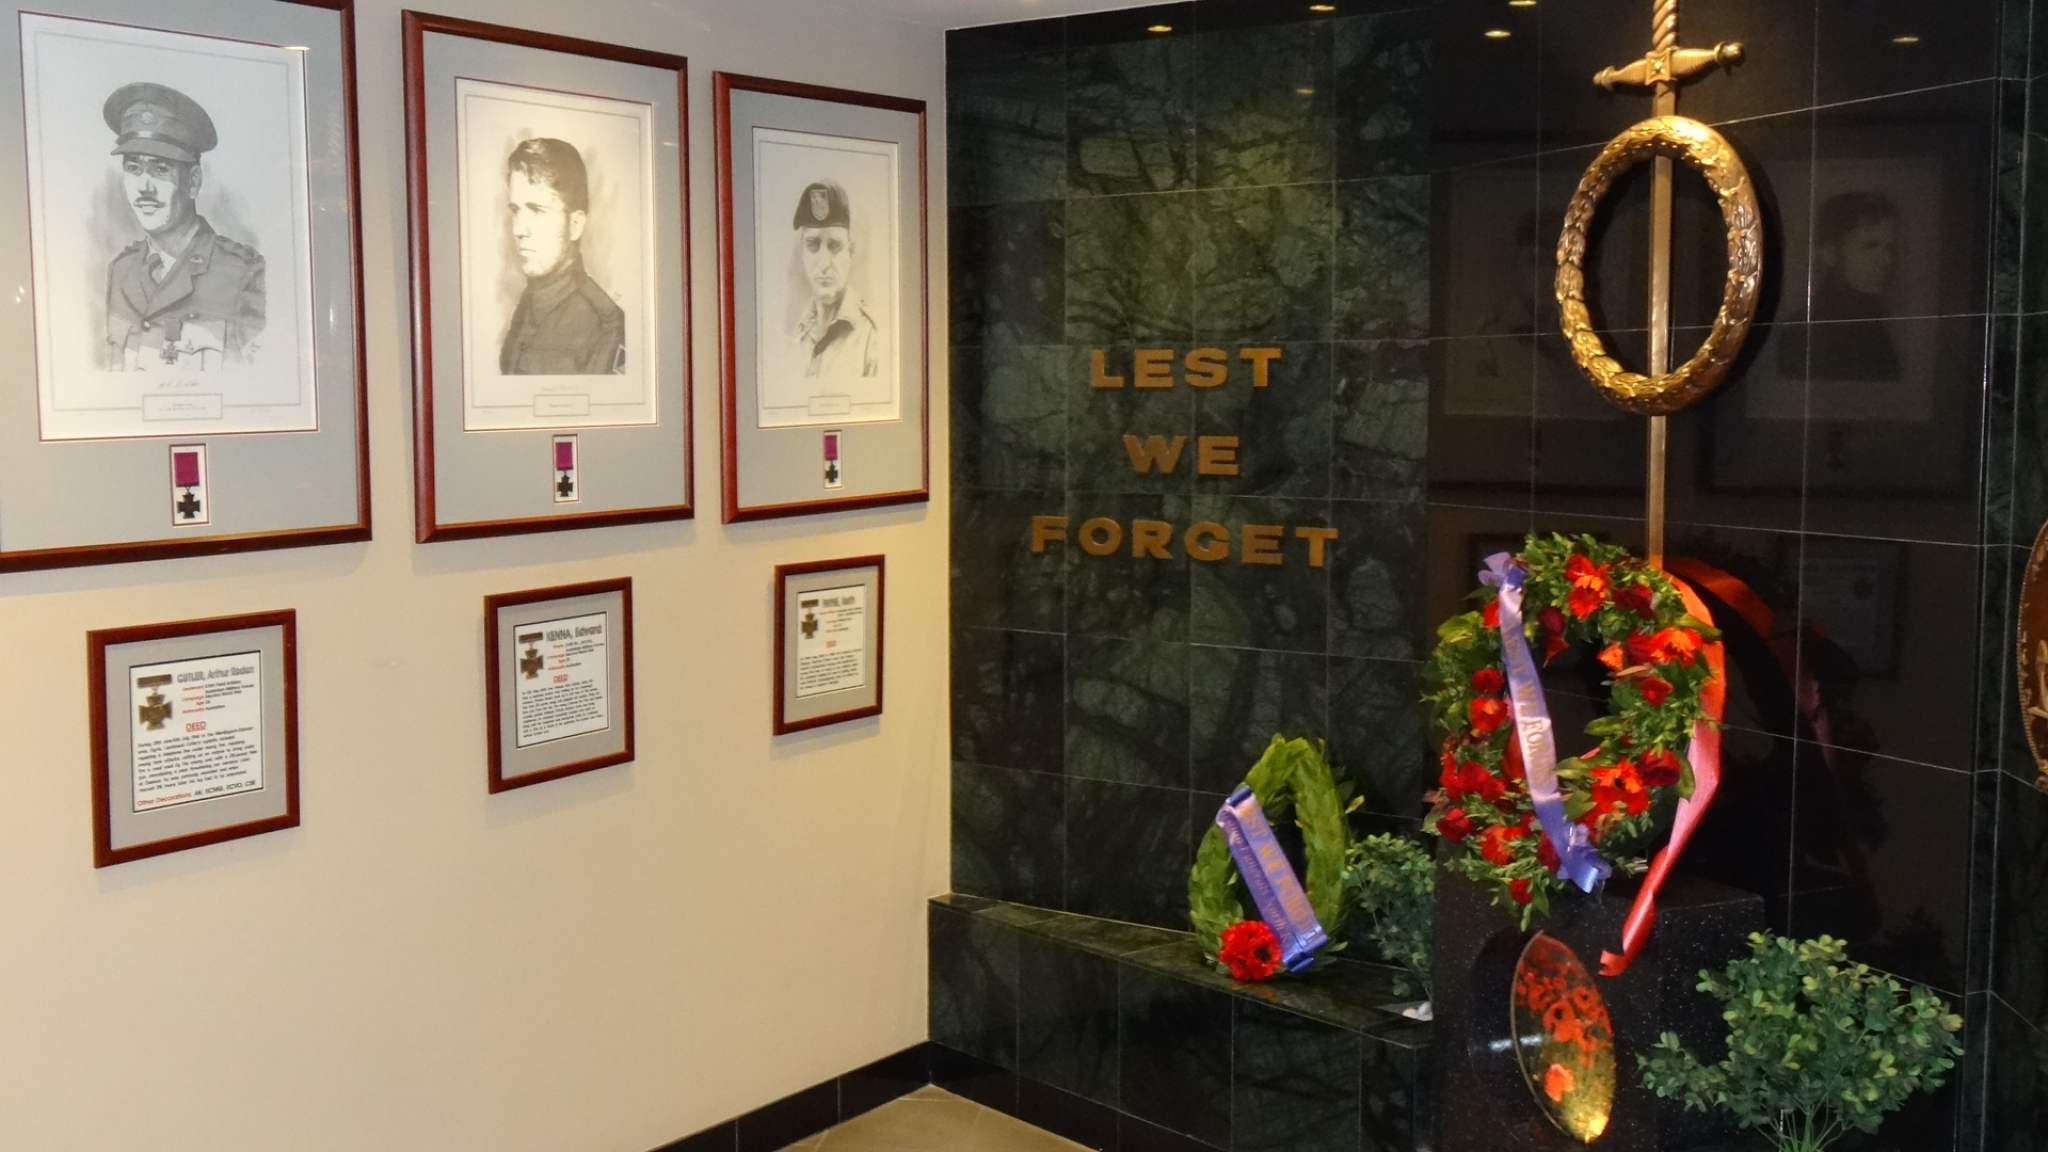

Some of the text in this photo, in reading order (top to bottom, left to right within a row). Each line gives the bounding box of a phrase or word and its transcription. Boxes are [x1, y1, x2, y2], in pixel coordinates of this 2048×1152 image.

[1089, 346, 1282, 389] LEST
[1121, 433, 1241, 476] WE
[1030, 513, 1339, 569] FORGET
[546, 625, 602, 643] KENNA, Edward
[177, 666, 254, 683] CUTLER, Arthur Roden
[186, 722, 206, 732] DEED
[156, 792, 192, 803] Decorations
[206, 786, 225, 794] KCMG,
